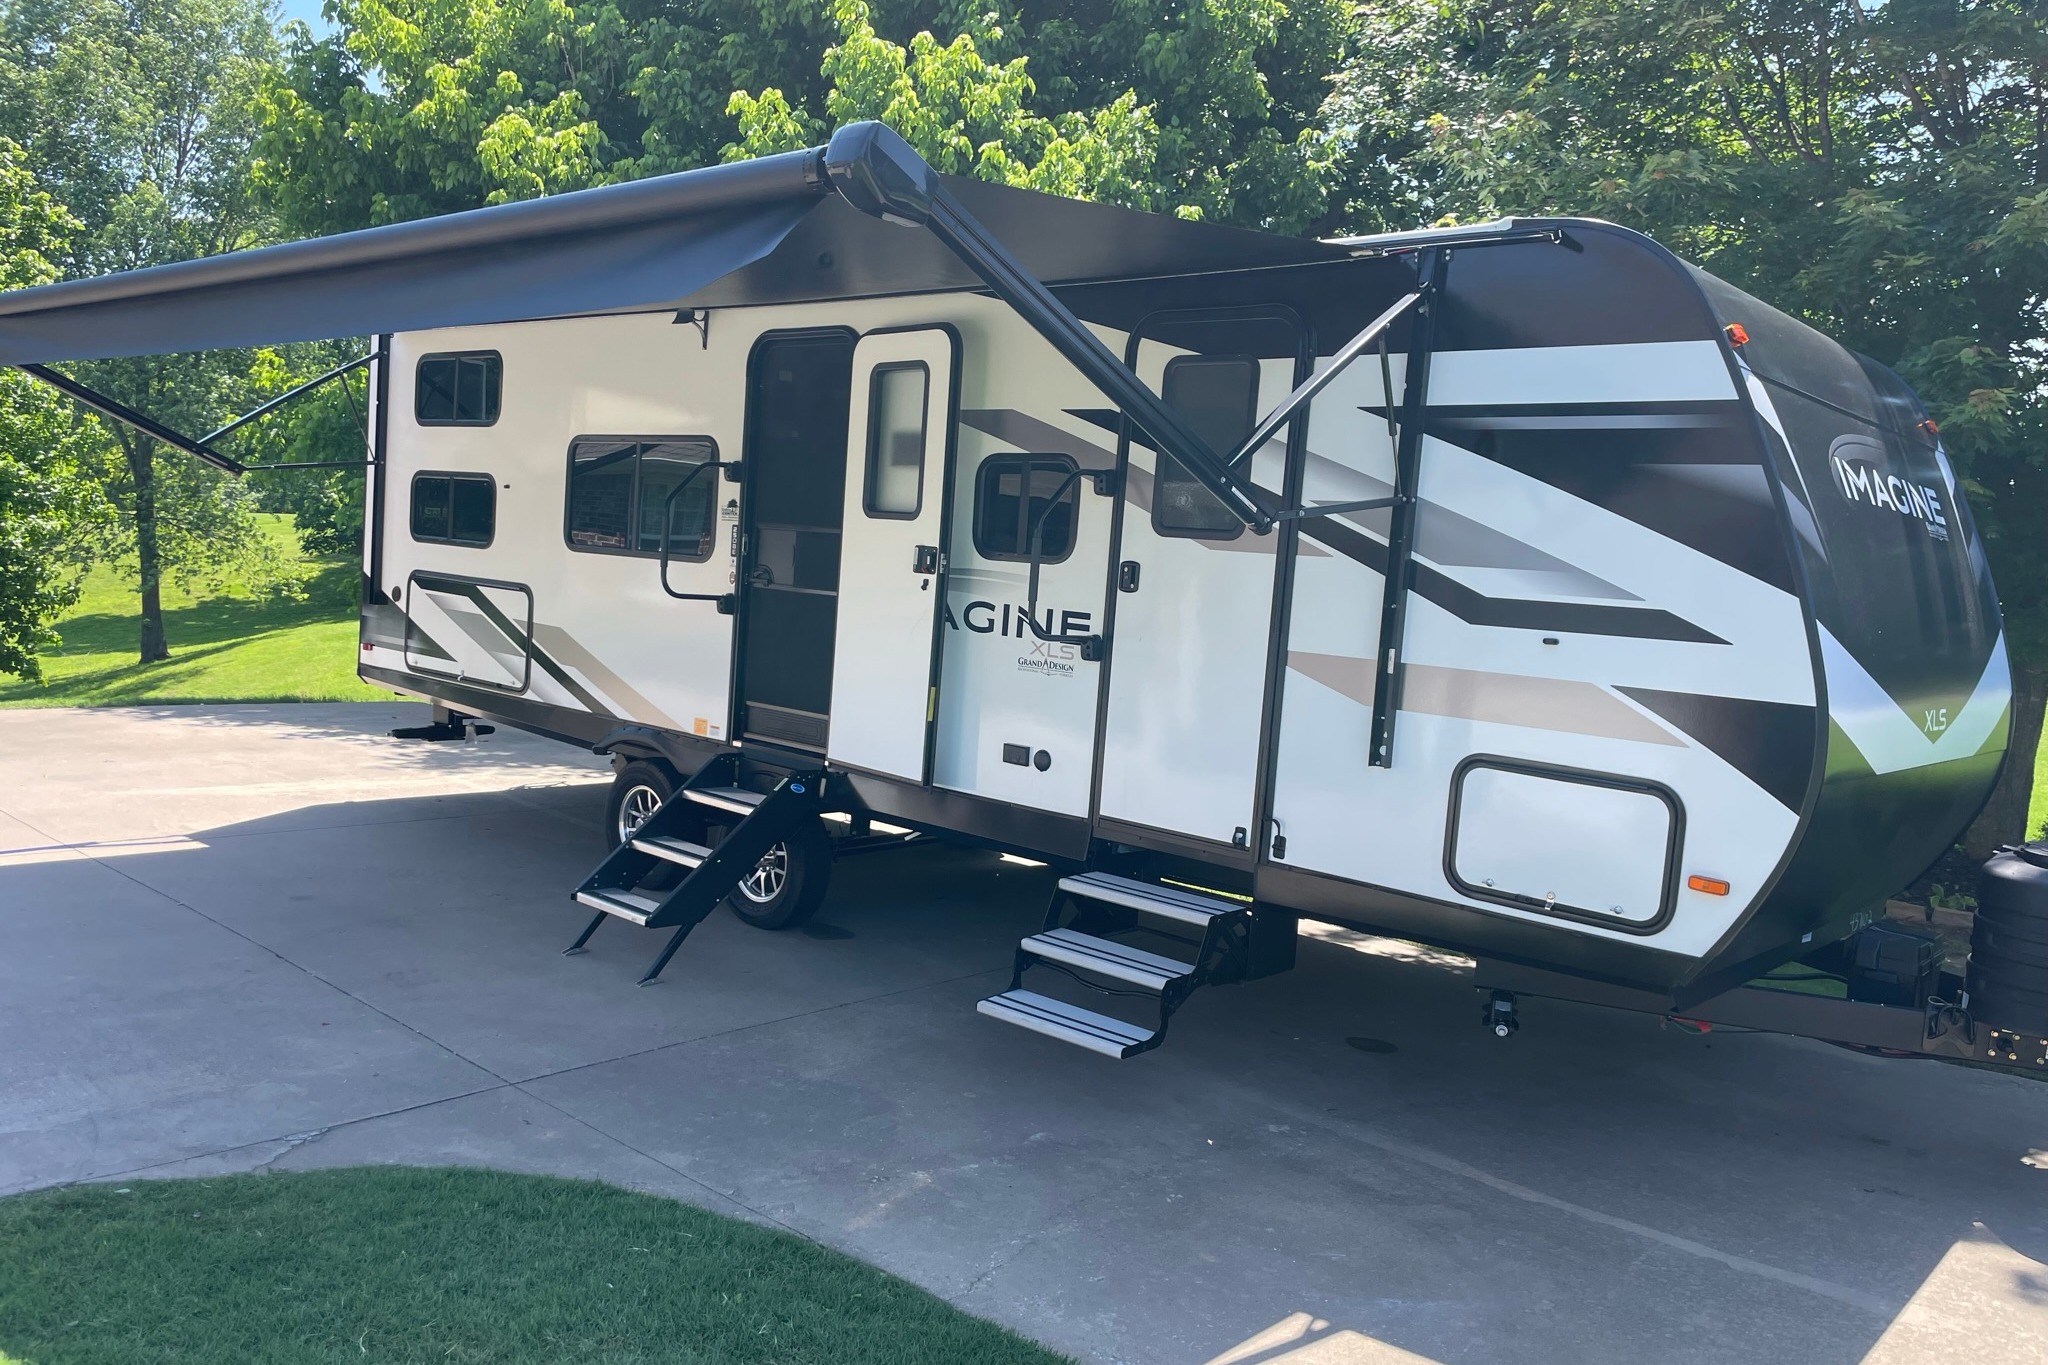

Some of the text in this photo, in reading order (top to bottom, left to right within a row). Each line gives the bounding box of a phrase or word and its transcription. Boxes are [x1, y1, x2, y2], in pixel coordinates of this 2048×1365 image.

[1833, 456, 1946, 525] IMAGINE
[1030, 641, 1074, 660] XLS
[1017, 657, 1042, 668] GRAND
[1050, 661, 1074, 672] DESIGN
[1924, 708, 1947, 732] XLS
